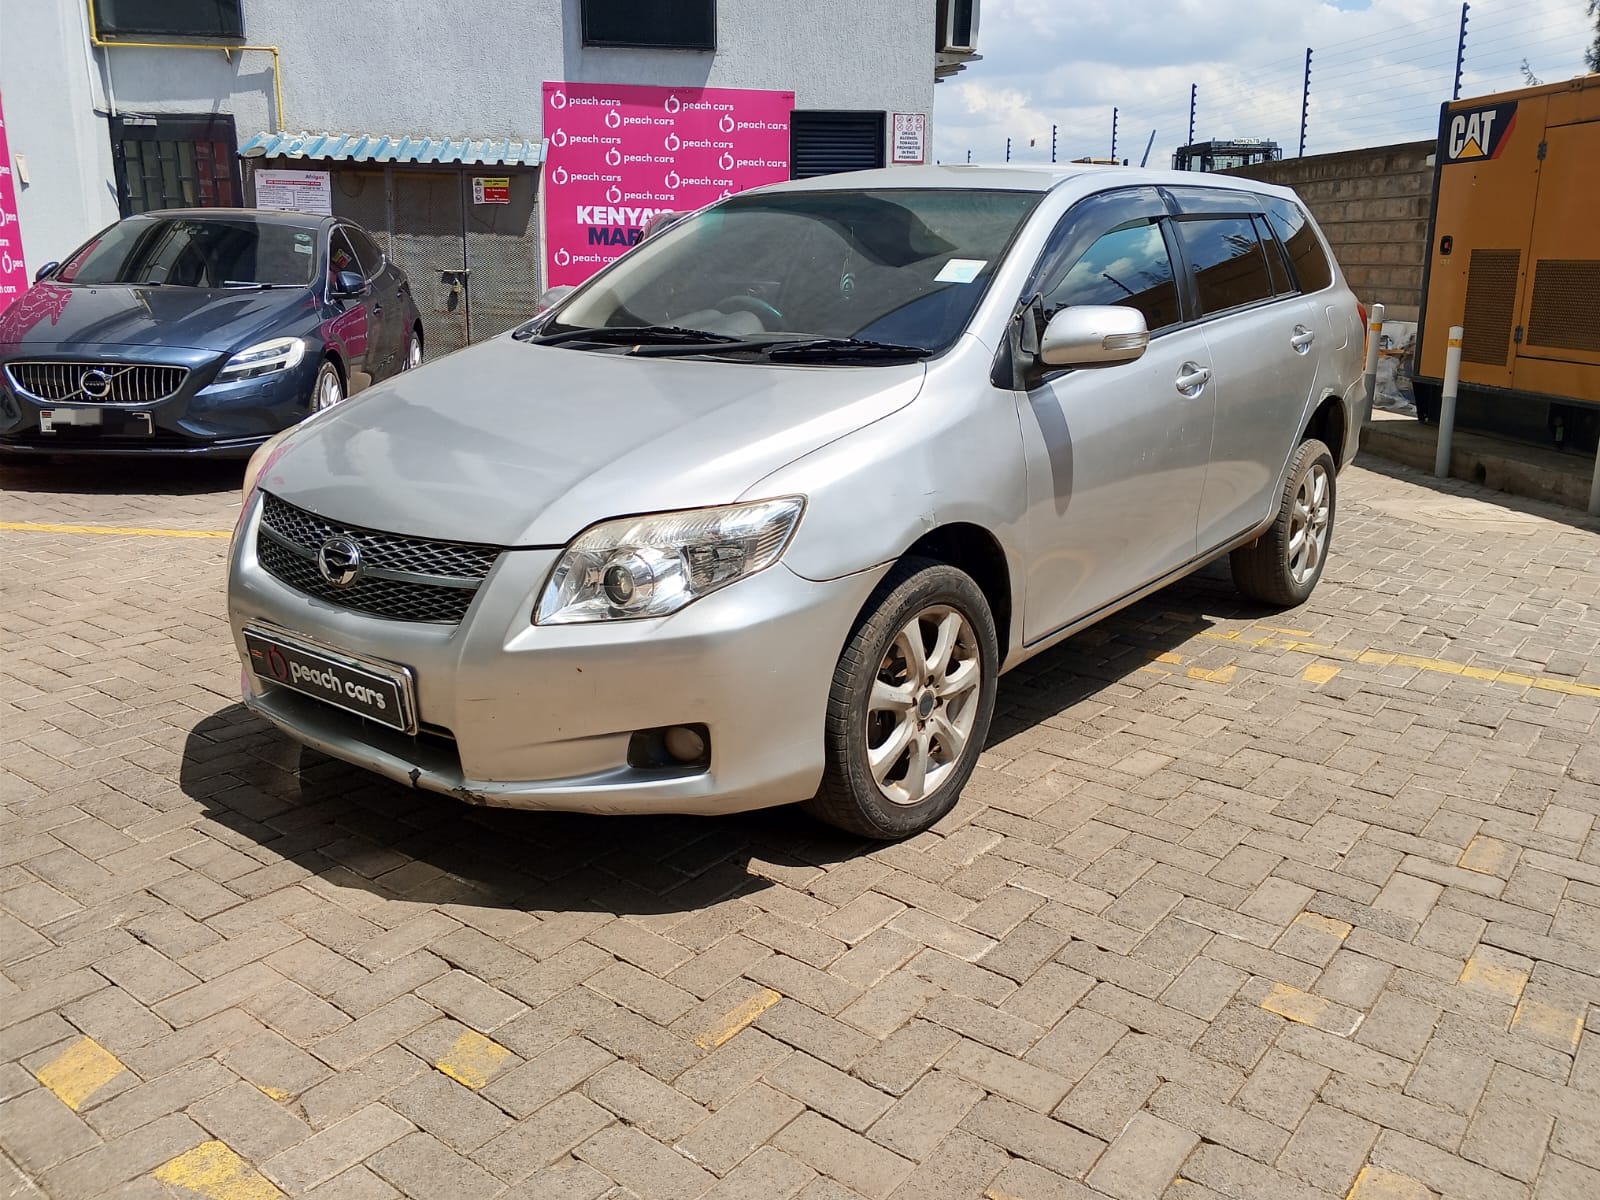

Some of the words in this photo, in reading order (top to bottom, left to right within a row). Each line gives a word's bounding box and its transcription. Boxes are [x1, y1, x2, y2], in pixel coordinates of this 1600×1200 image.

[569, 95, 598, 108] peach
[599, 99, 621, 107] cars
[682, 100, 711, 112] peach
[712, 103, 734, 111] cars
[623, 115, 652, 127] peach
[653, 118, 674, 126] cars
[737, 120, 765, 132] peach
[767, 123, 787, 131] cars
[569, 134, 598, 146] peach
[600, 137, 621, 145] cars
[1449, 110, 1497, 159] CAT
[682, 138, 711, 150] peach
[712, 141, 733, 149] cars
[623, 153, 652, 165] peach
[653, 156, 674, 164] cars
[736, 157, 765, 169] peach
[766, 160, 786, 168] cars
[570, 171, 599, 183] peach
[600, 174, 621, 182] cars
[682, 176, 711, 188] peach
[712, 179, 733, 187] cars
[624, 190, 652, 202] peach
[654, 193, 674, 201] cars
[572, 253, 600, 265] peach
[290, 661, 342, 693] peach
[345, 681, 387, 709] cars
